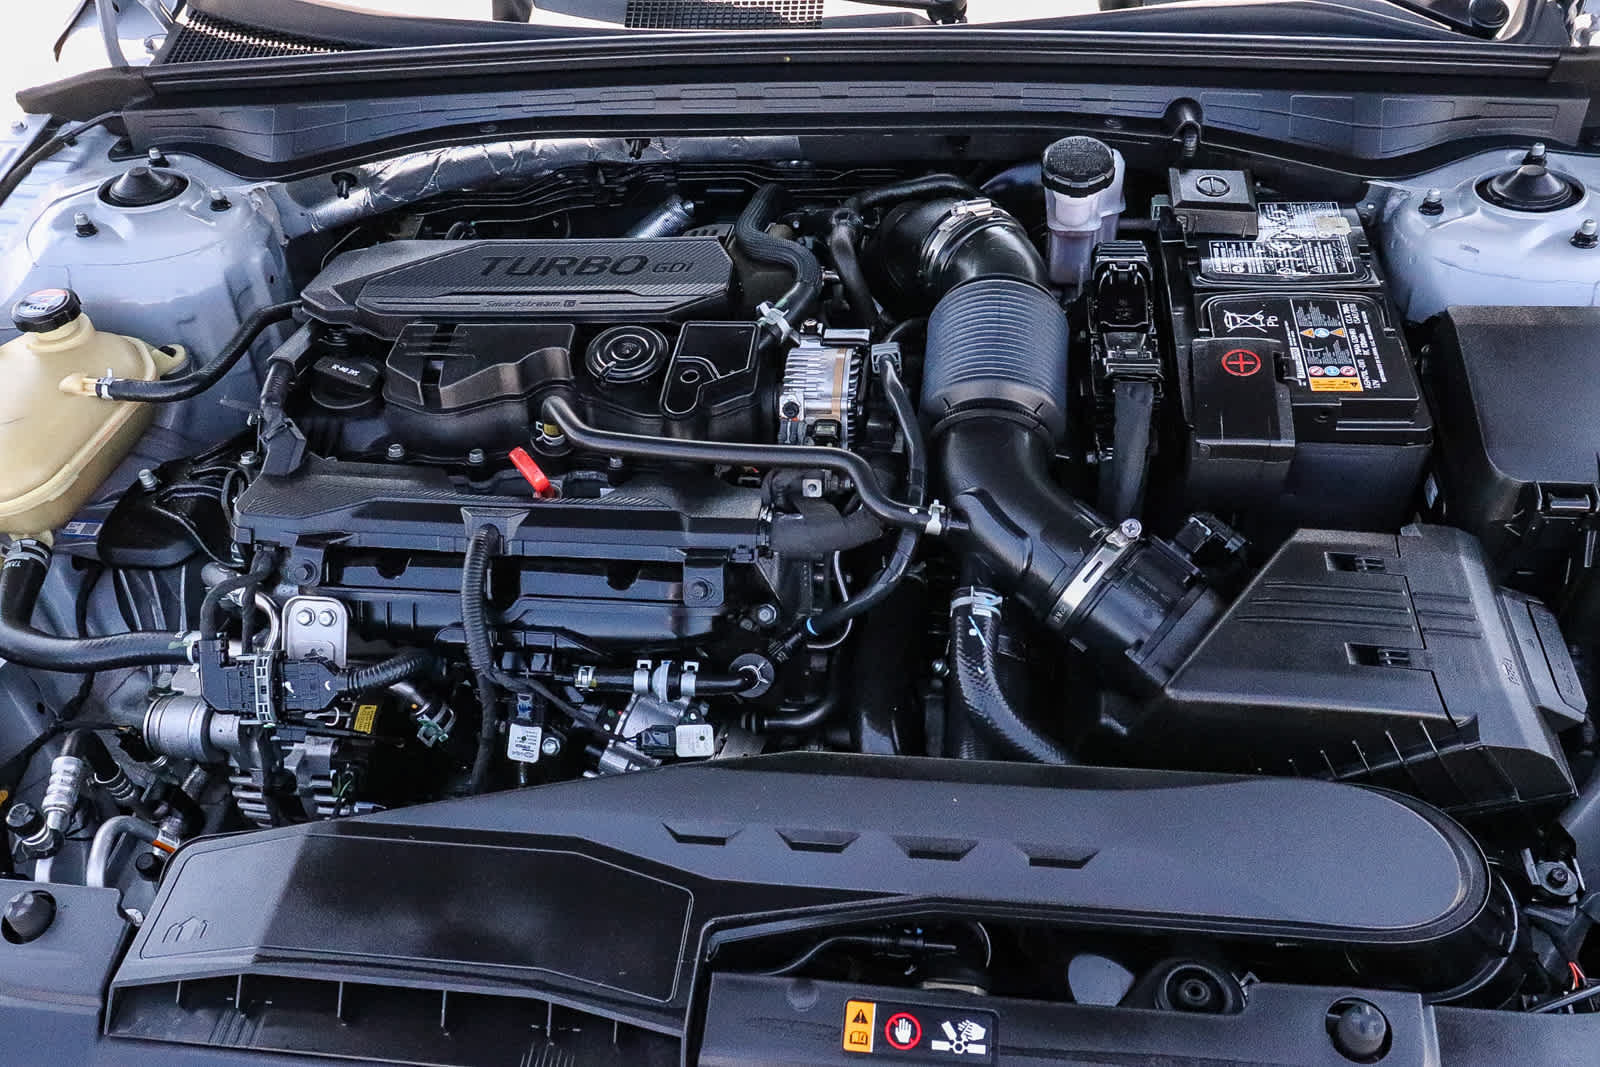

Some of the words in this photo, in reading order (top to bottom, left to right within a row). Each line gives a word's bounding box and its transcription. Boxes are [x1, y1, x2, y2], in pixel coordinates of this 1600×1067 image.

[481, 254, 648, 276] TURBO
[484, 300, 560, 308] Smartstream
[1266, 315, 1279, 327] Pb
